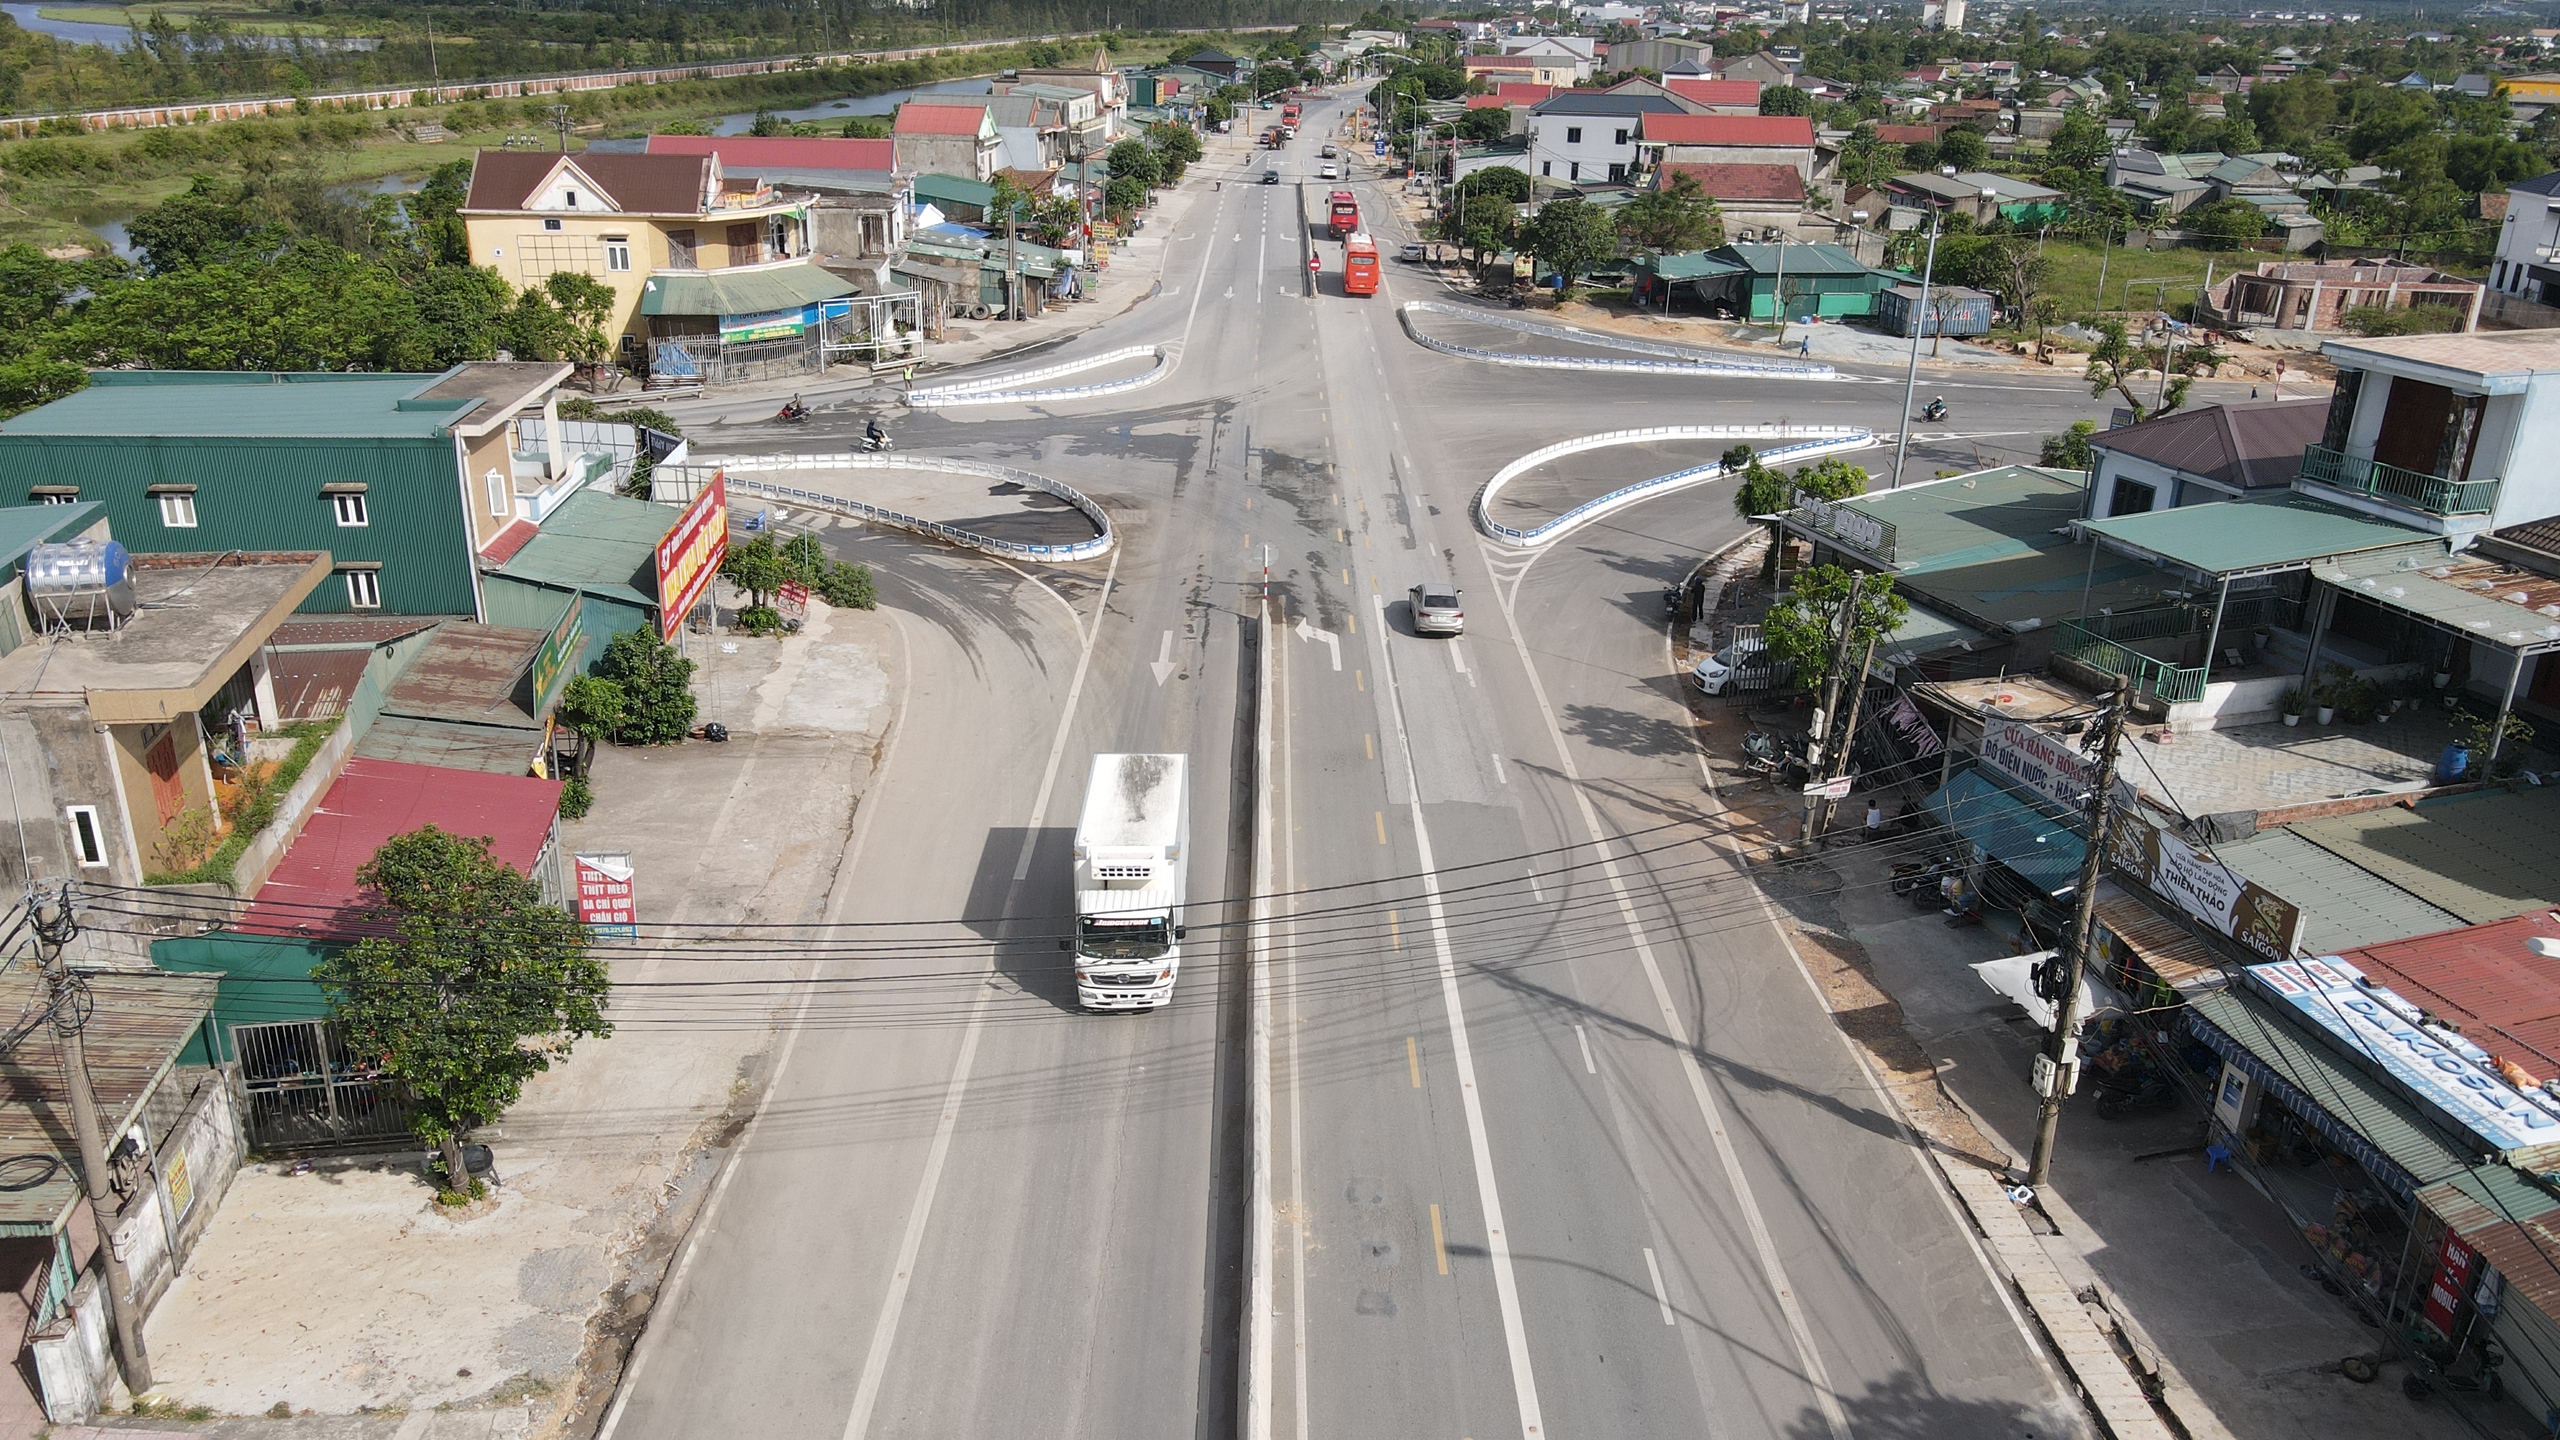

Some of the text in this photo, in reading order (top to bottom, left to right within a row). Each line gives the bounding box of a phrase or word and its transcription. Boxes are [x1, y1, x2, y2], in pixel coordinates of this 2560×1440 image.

[1834, 509, 1882, 550] 1999
[2026, 737, 2055, 765] HÀNG
[1999, 748, 2020, 774] ĐIỆN
[2022, 761, 2048, 790] NƯỚC
[582, 884, 604, 896] THỊT
[2194, 872, 2207, 885] LAO
[582, 899, 594, 910] BA
[612, 898, 632, 910] QUAY
[2196, 887, 2225, 911] THẢO
[2256, 931, 2270, 943] BIA
[2343, 999, 2556, 1130] DAIKIOSAN
[2451, 1086, 2484, 1108] CAO
